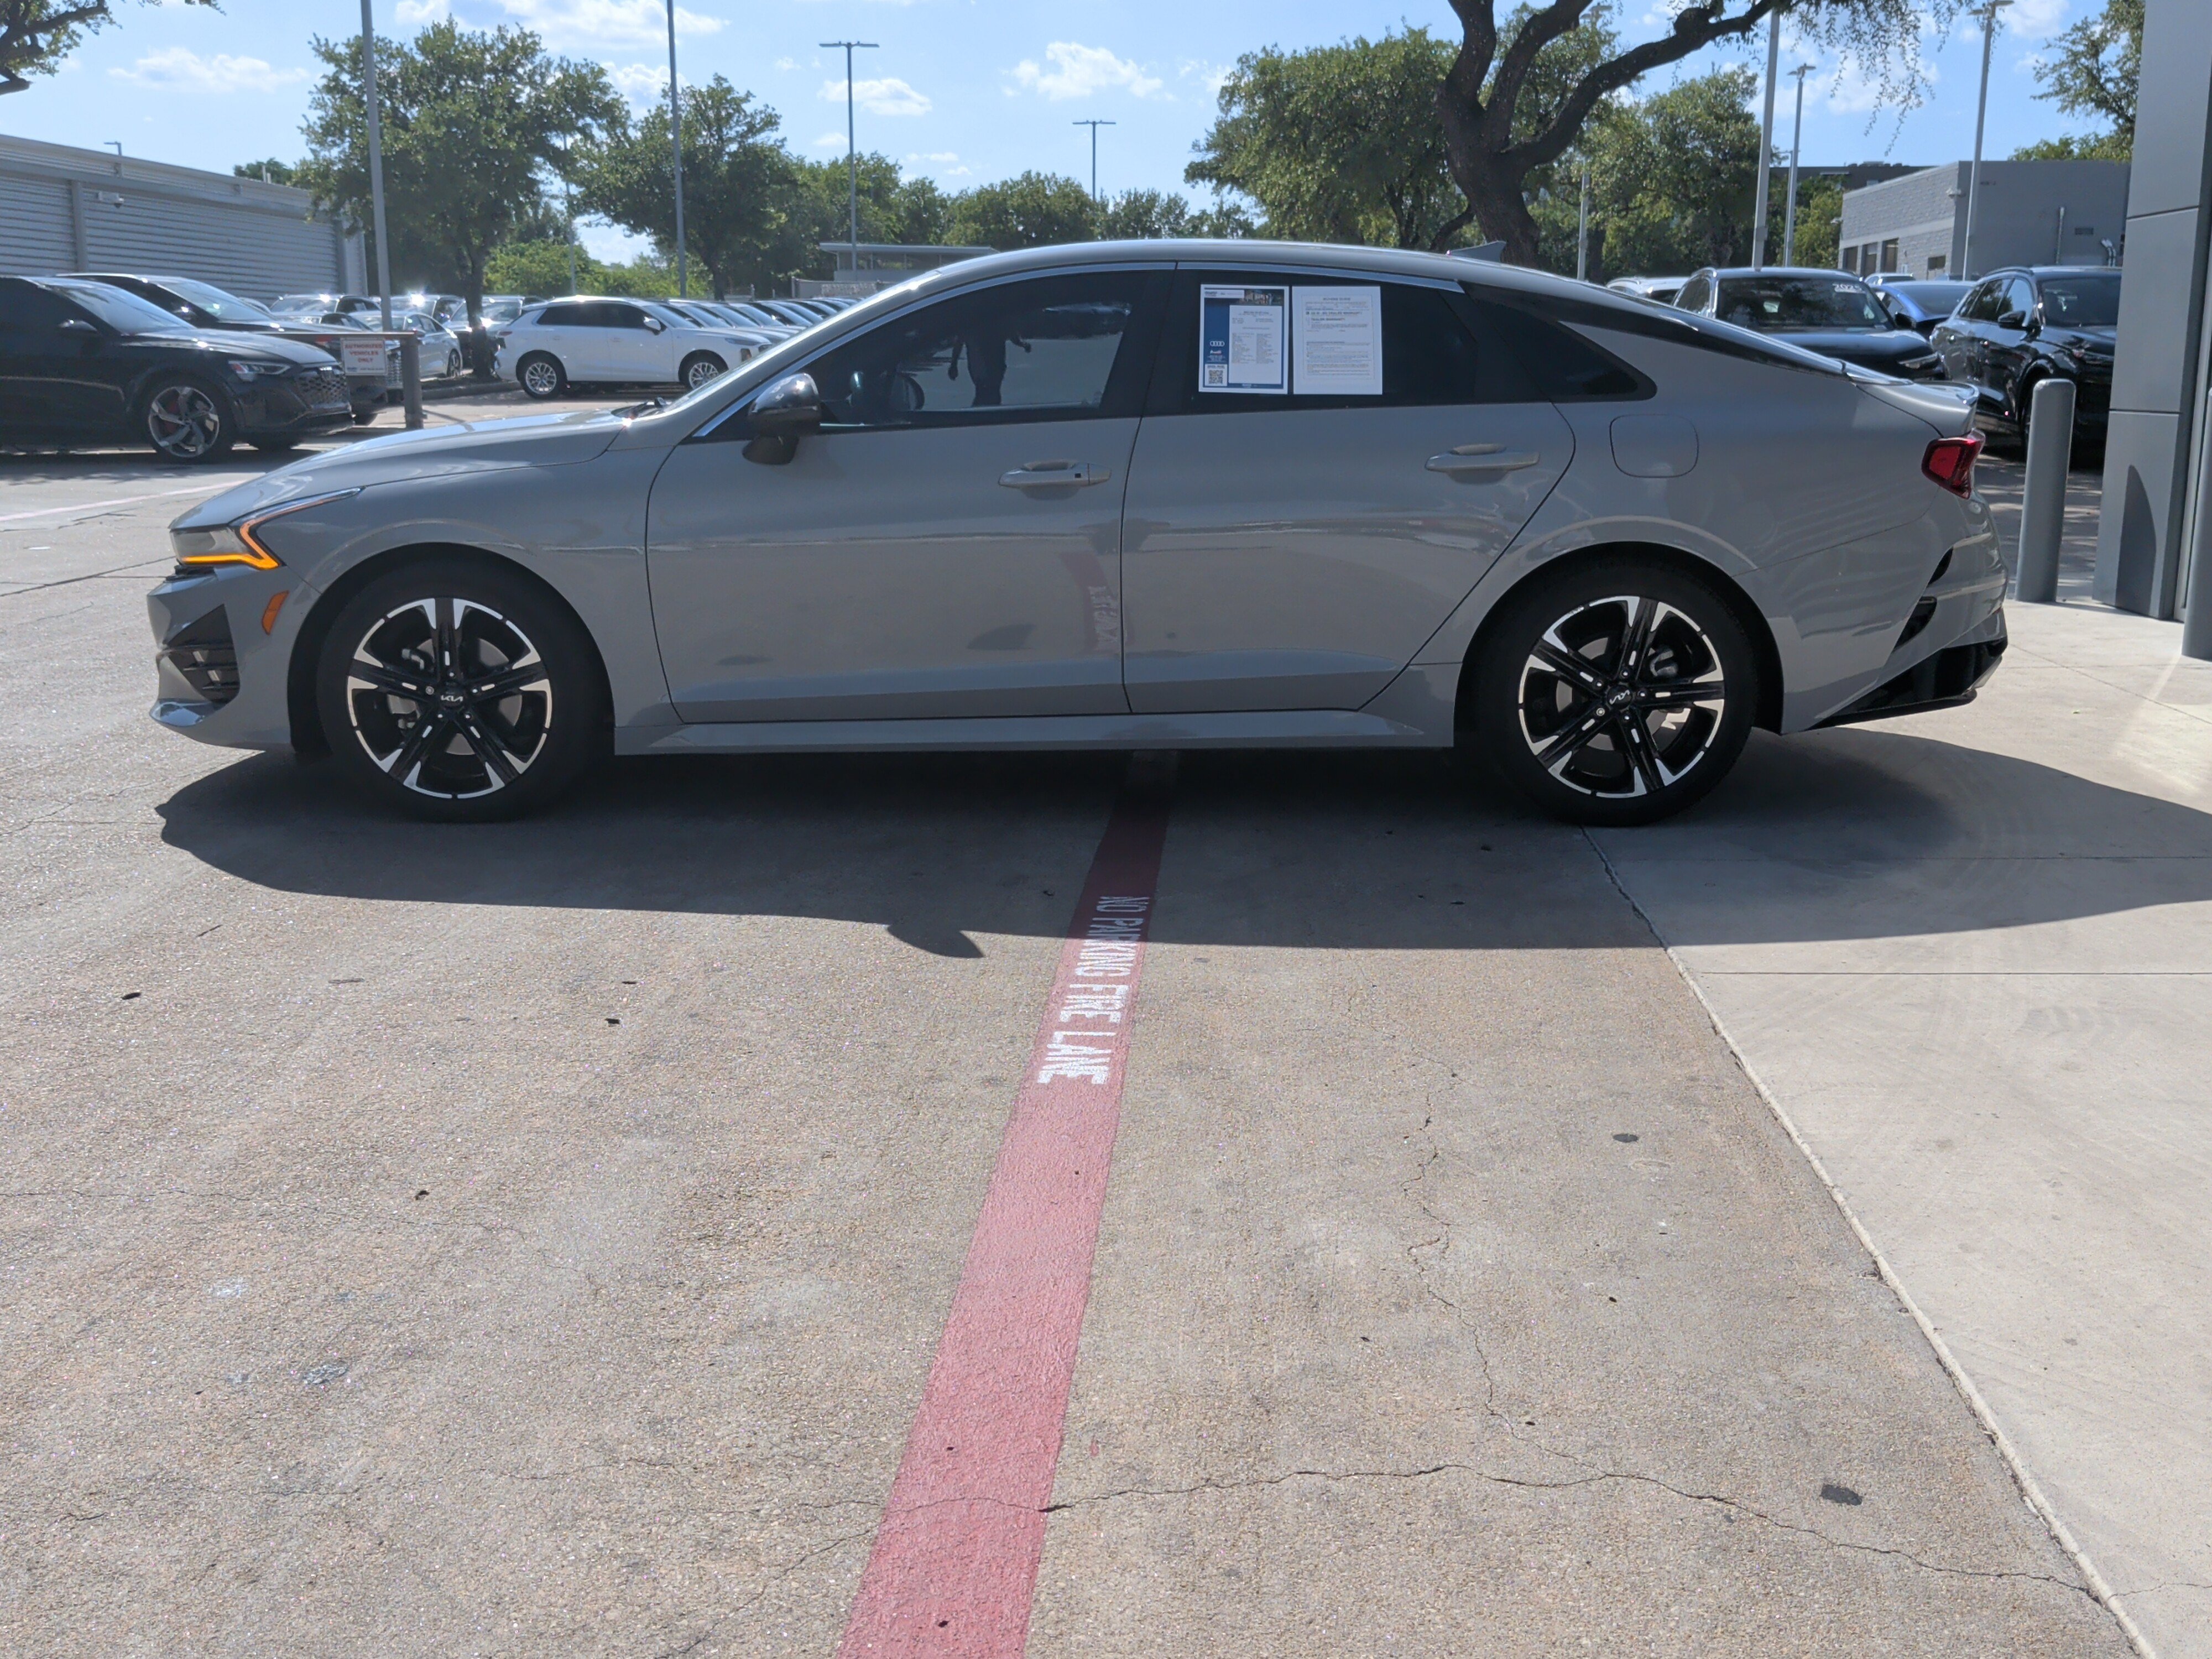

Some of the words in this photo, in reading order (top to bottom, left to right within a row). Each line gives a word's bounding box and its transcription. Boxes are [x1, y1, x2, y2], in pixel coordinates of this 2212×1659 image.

[1096, 896, 1150, 912] NO
[1074, 917, 1144, 977] PARKING
[1060, 984, 1130, 1023] FIRE
[1037, 1031, 1117, 1084] LANE
